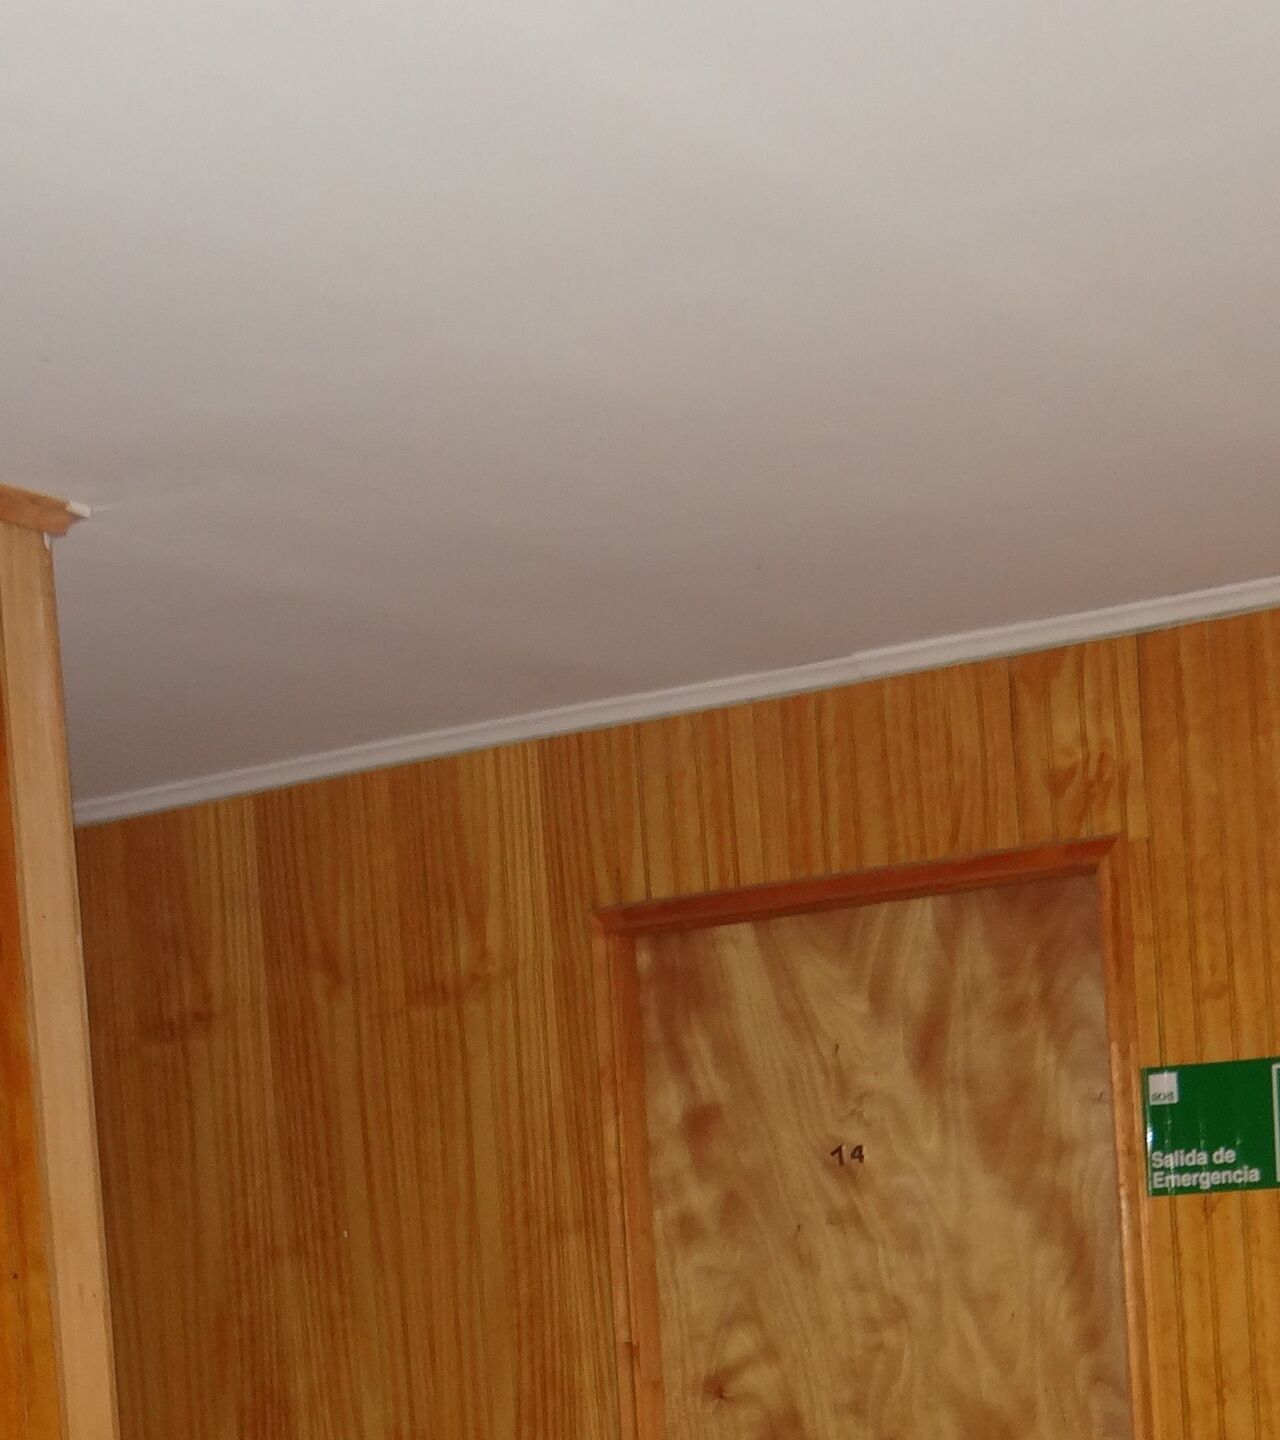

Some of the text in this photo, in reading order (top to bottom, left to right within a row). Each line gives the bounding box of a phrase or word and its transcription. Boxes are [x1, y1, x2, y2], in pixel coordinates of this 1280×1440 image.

[830, 1144, 865, 1167] 14
[1151, 1146, 1236, 1168] Salida de
[1153, 1166, 1261, 1190] Emergencia
